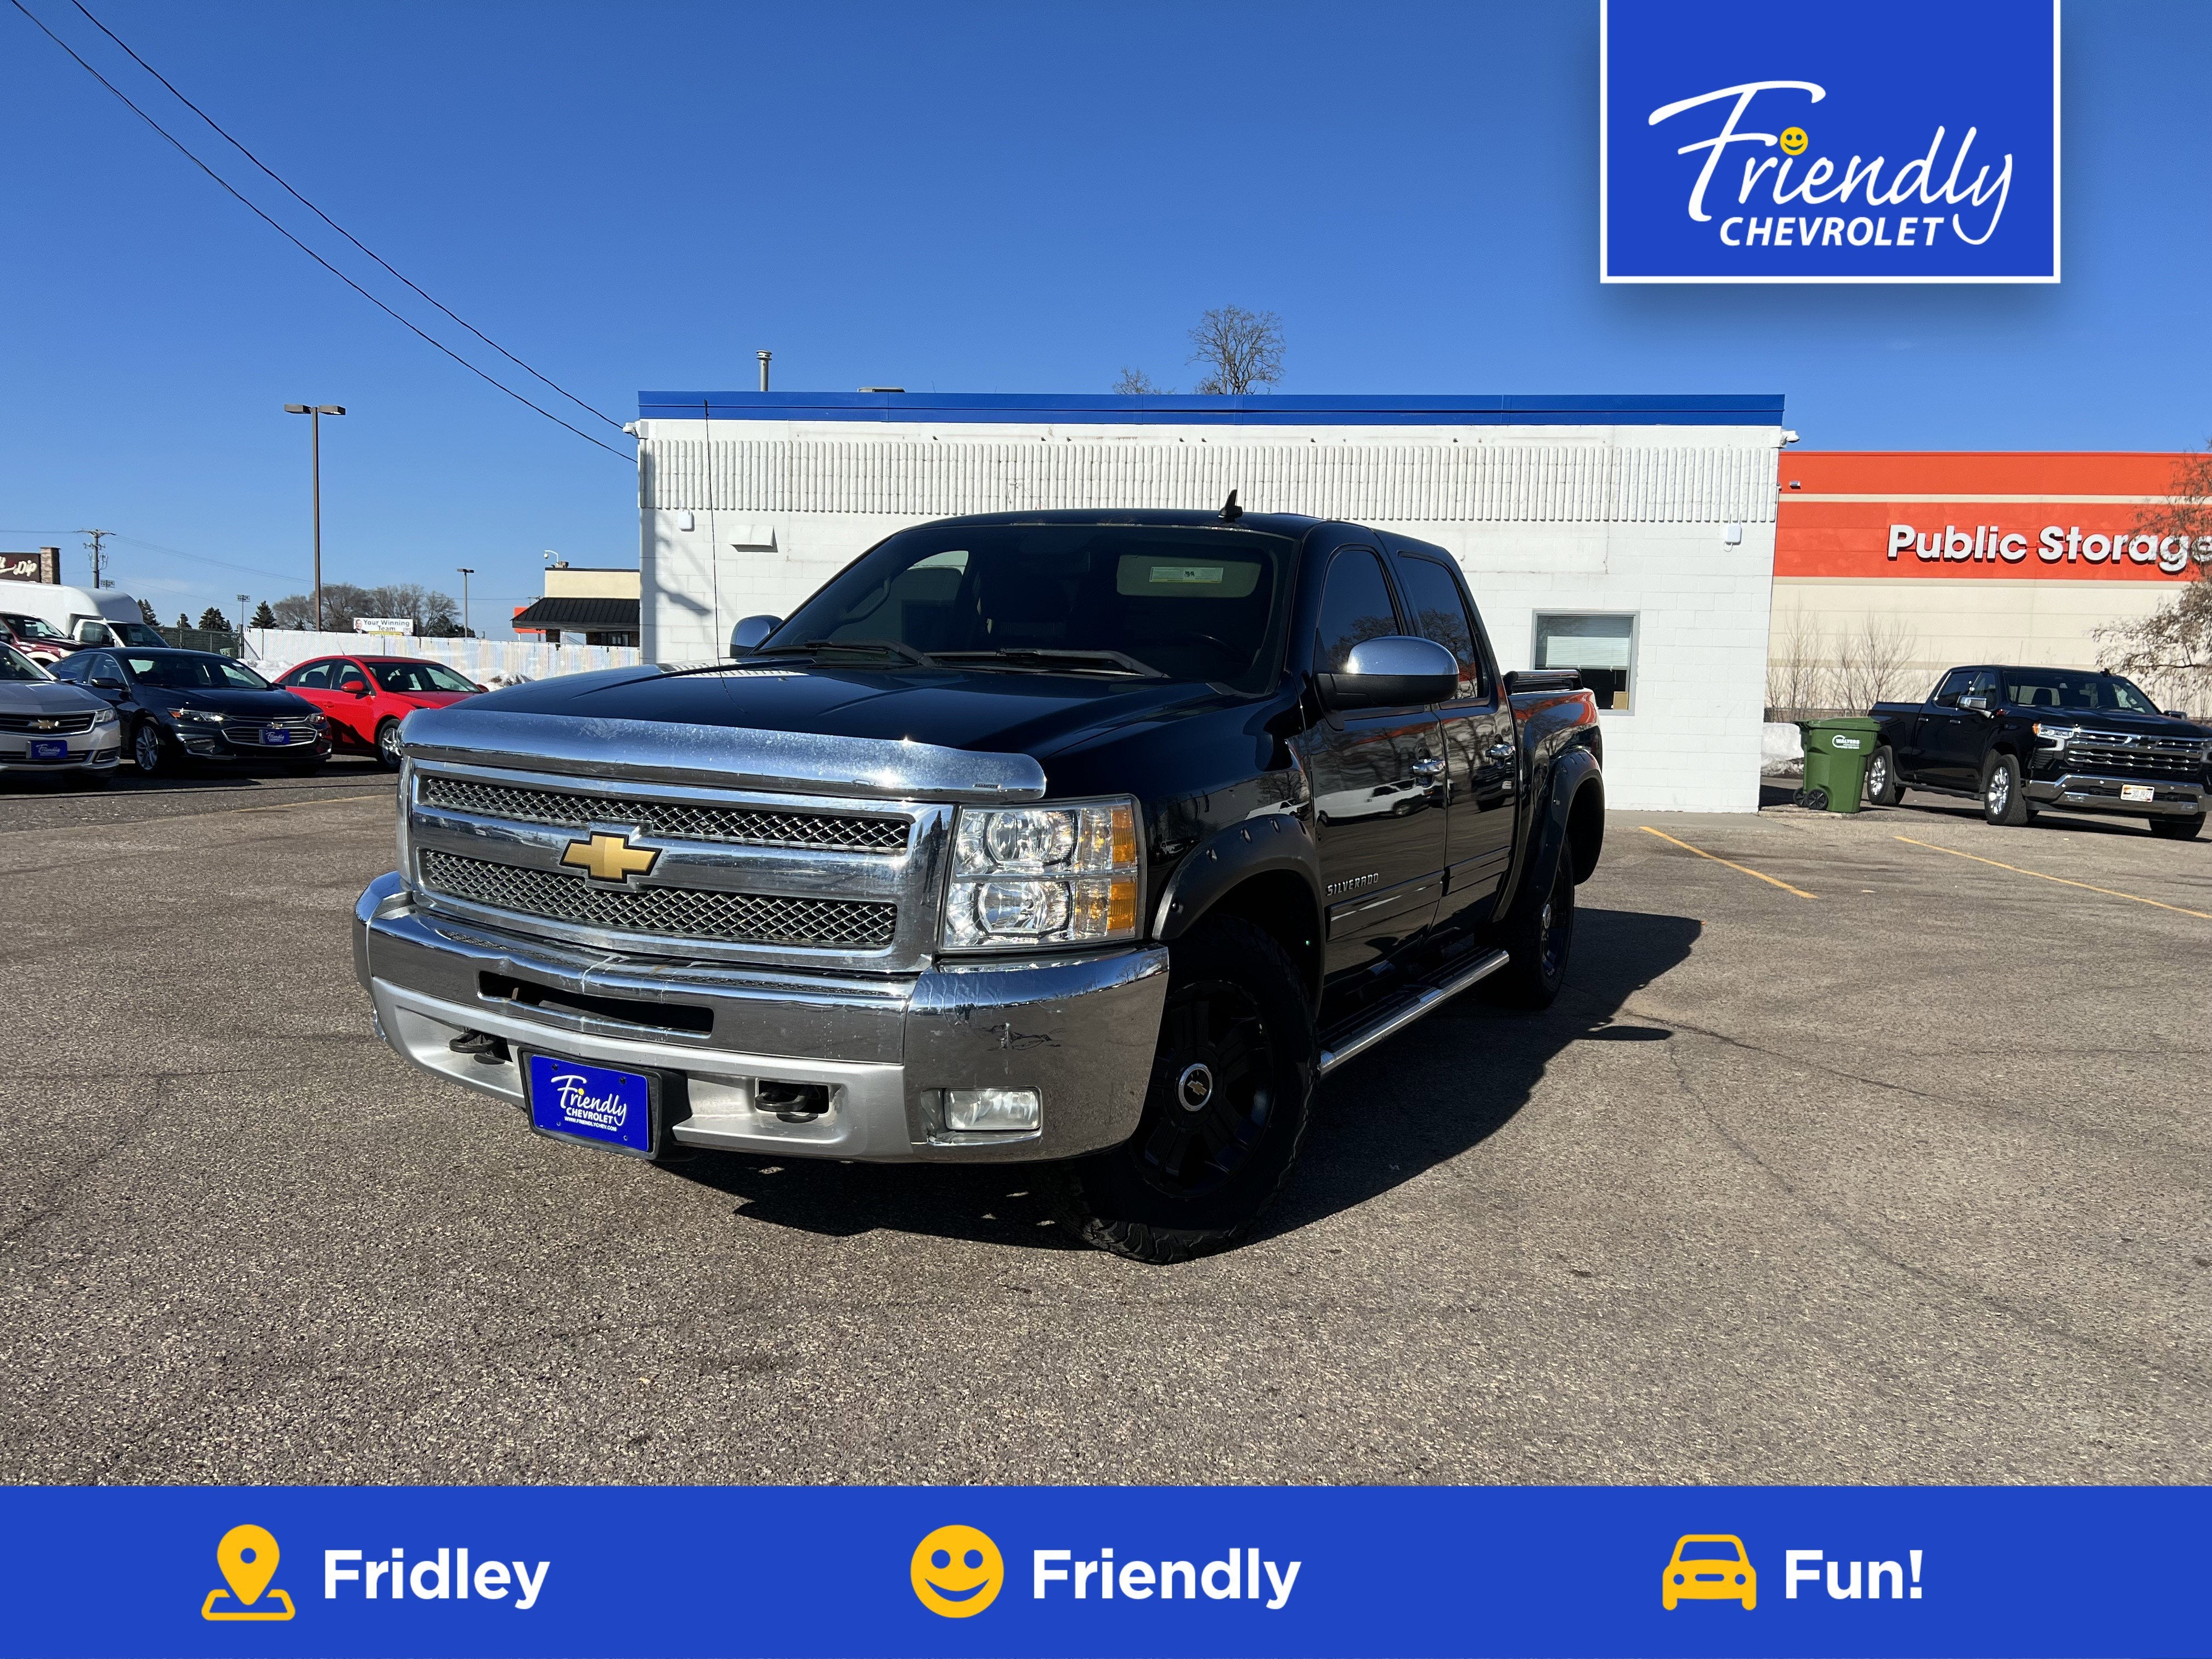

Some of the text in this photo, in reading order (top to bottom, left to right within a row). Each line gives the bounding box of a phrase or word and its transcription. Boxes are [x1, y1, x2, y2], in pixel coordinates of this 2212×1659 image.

[1888, 524, 2212, 573] Public Storage
[13, 560, 37, 577] Dip
[1327, 872, 1379, 896] SILVERADO
[551, 1075, 627, 1126] Friendly
[564, 1116, 617, 1132] WWW.FRIENDLYCHEV.COM
[566, 1107, 614, 1124] CHEVROLET
